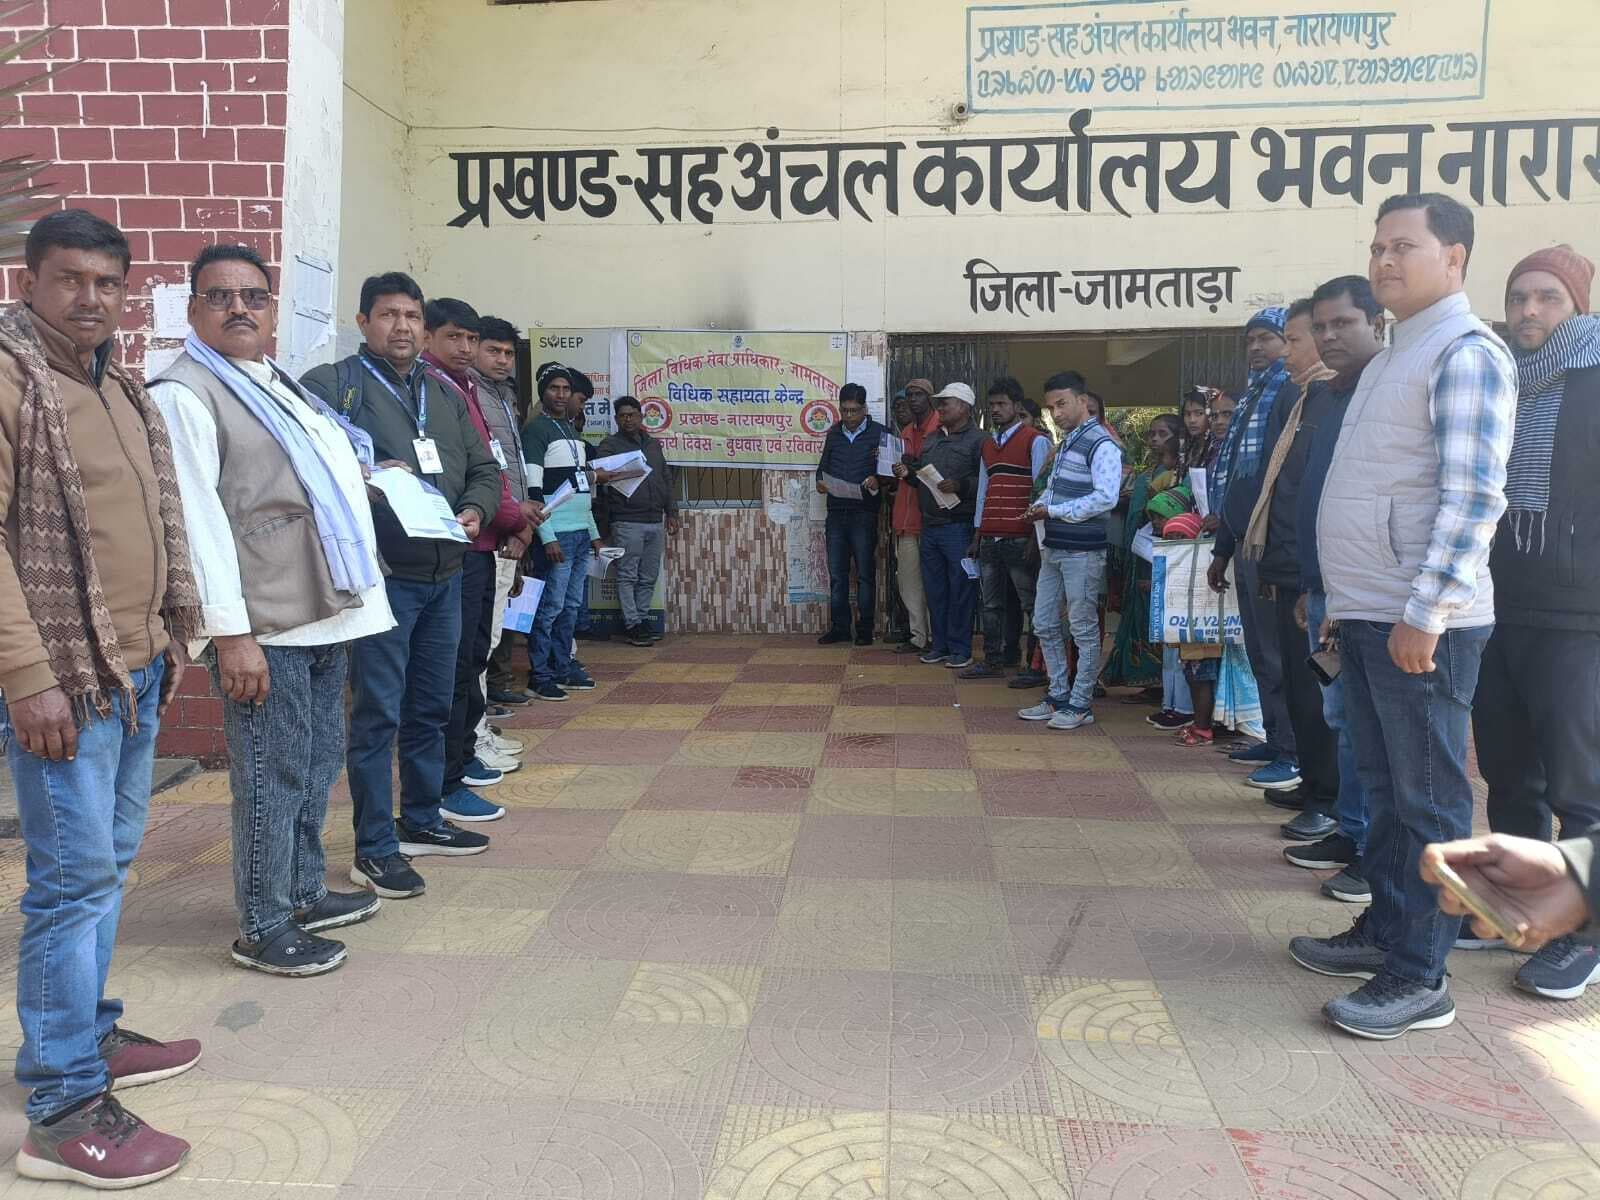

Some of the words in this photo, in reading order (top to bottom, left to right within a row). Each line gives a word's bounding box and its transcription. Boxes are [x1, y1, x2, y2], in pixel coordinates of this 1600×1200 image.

[1141, 8, 1226, 57] कार्यालय
[1283, 12, 1397, 50] नारायणपुर
[731, 127, 907, 223] अंचल
[913, 108, 1240, 218] कार्यालय
[1250, 123, 1435, 209] भवन
[634, 368, 663, 398] जिला
[665, 354, 704, 379] विधिक
[706, 349, 731, 369] सेवा
[668, 382, 713, 403] विधिक
[717, 388, 770, 406] सहायता
[774, 383, 805, 405] केन्द्र
[681, 432, 712, 451] दिवस
[726, 438, 763, 457] बुधवार
[766, 434, 783, 454] एवं
